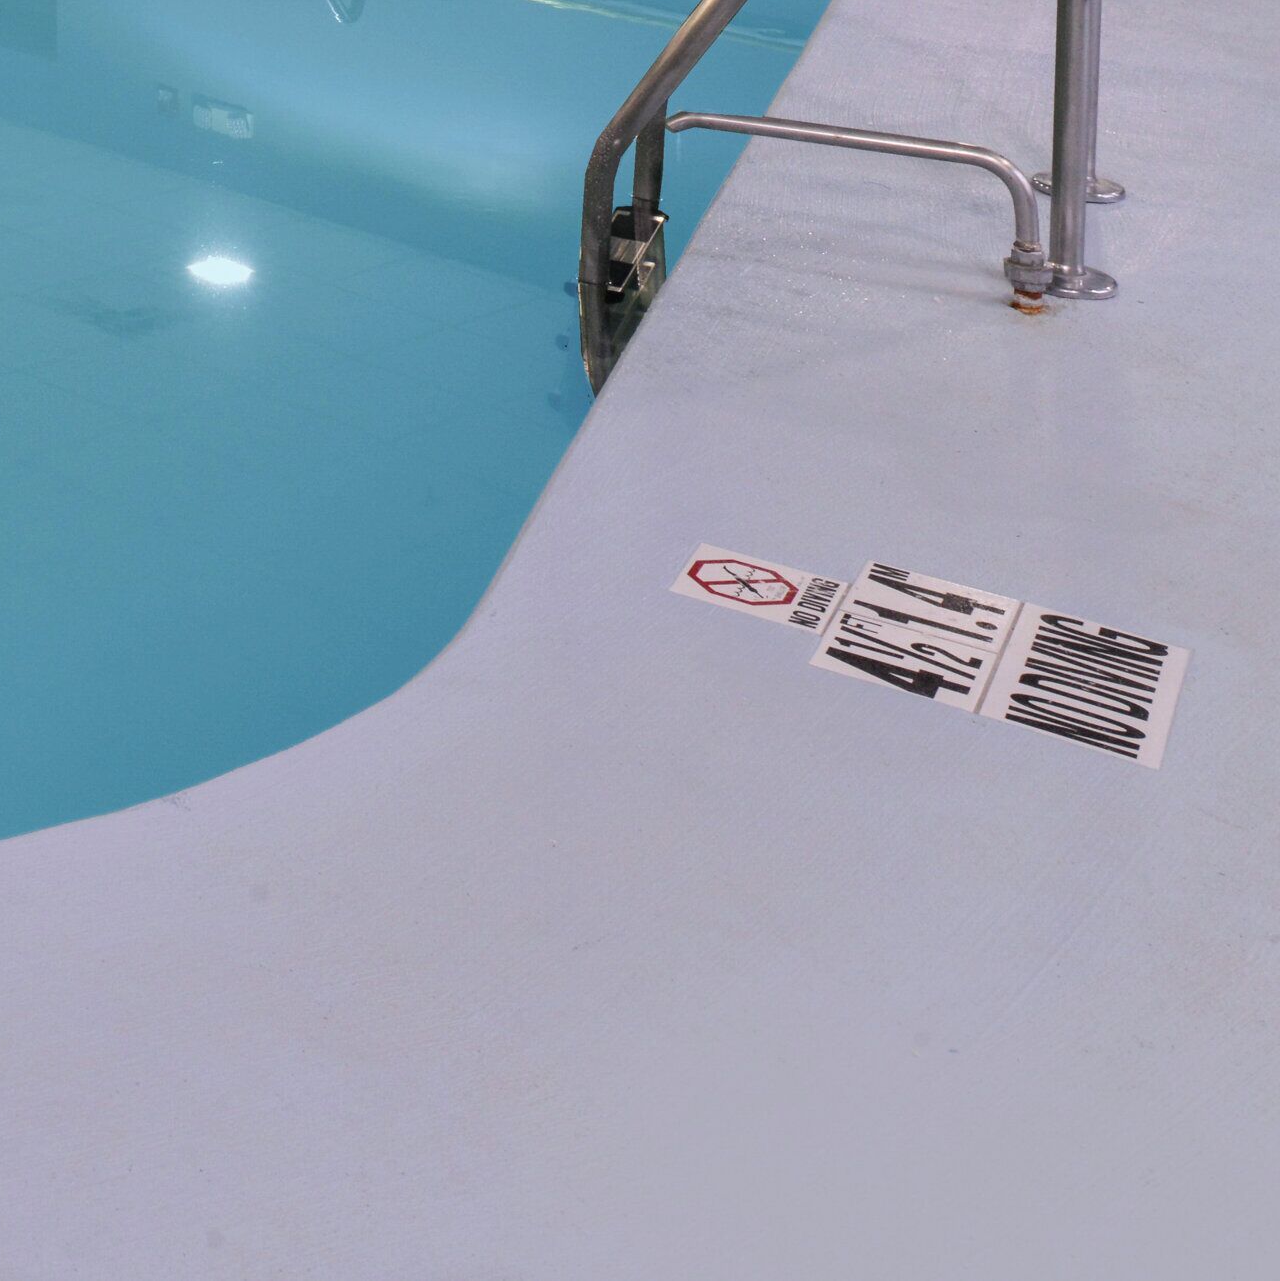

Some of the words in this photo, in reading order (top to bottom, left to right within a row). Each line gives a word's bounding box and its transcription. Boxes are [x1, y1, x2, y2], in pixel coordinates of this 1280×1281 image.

[787, 609, 822, 630] NO
[797, 577, 841, 613] DIVING
[1018, 613, 1169, 722] DIVING
[1005, 693, 1146, 760] NO
